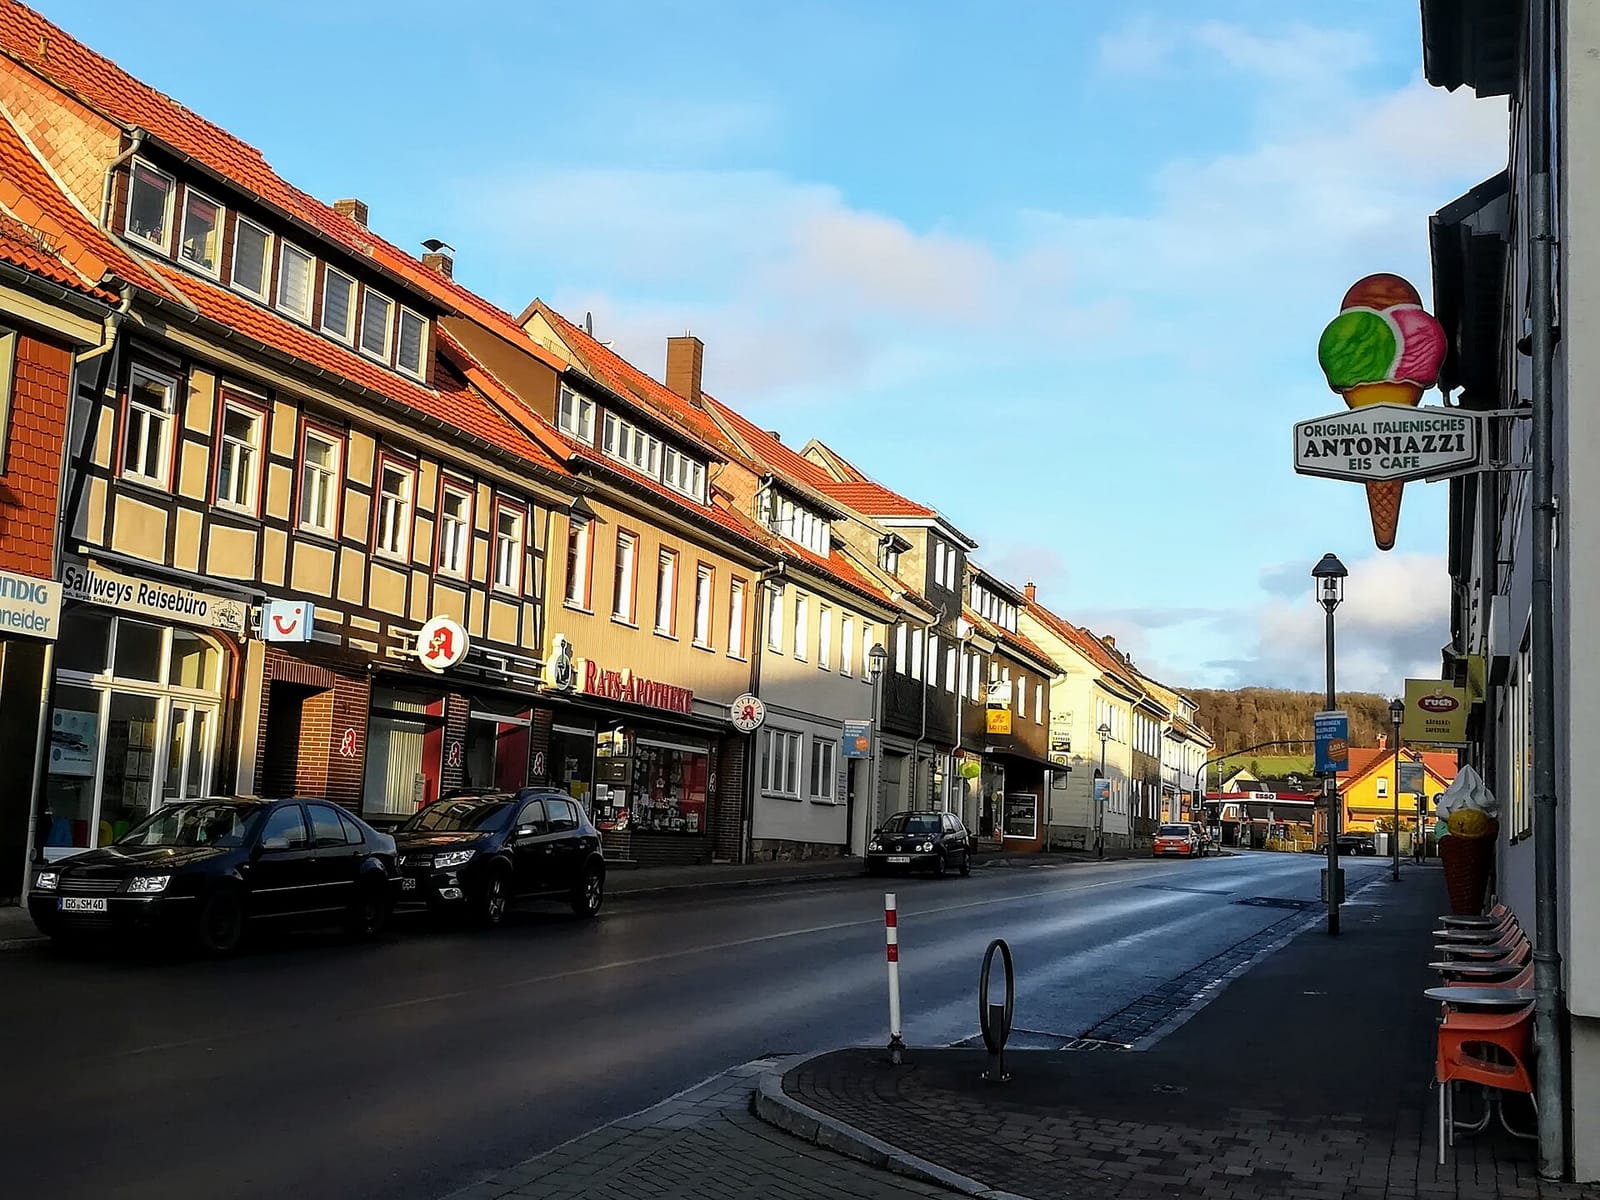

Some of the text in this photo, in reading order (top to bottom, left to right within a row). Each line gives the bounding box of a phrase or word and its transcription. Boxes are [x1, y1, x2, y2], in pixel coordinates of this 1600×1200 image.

[1303, 419, 1465, 437] ORIGINAL ITALIENISCHES
[1303, 434, 1466, 458] ANTONIAZZI
[1349, 456, 1420, 470] EIS CAFE
[0, 576, 48, 604] NDIG
[63, 567, 207, 616] Sallweys Reisebüro
[0, 608, 51, 632] neider
